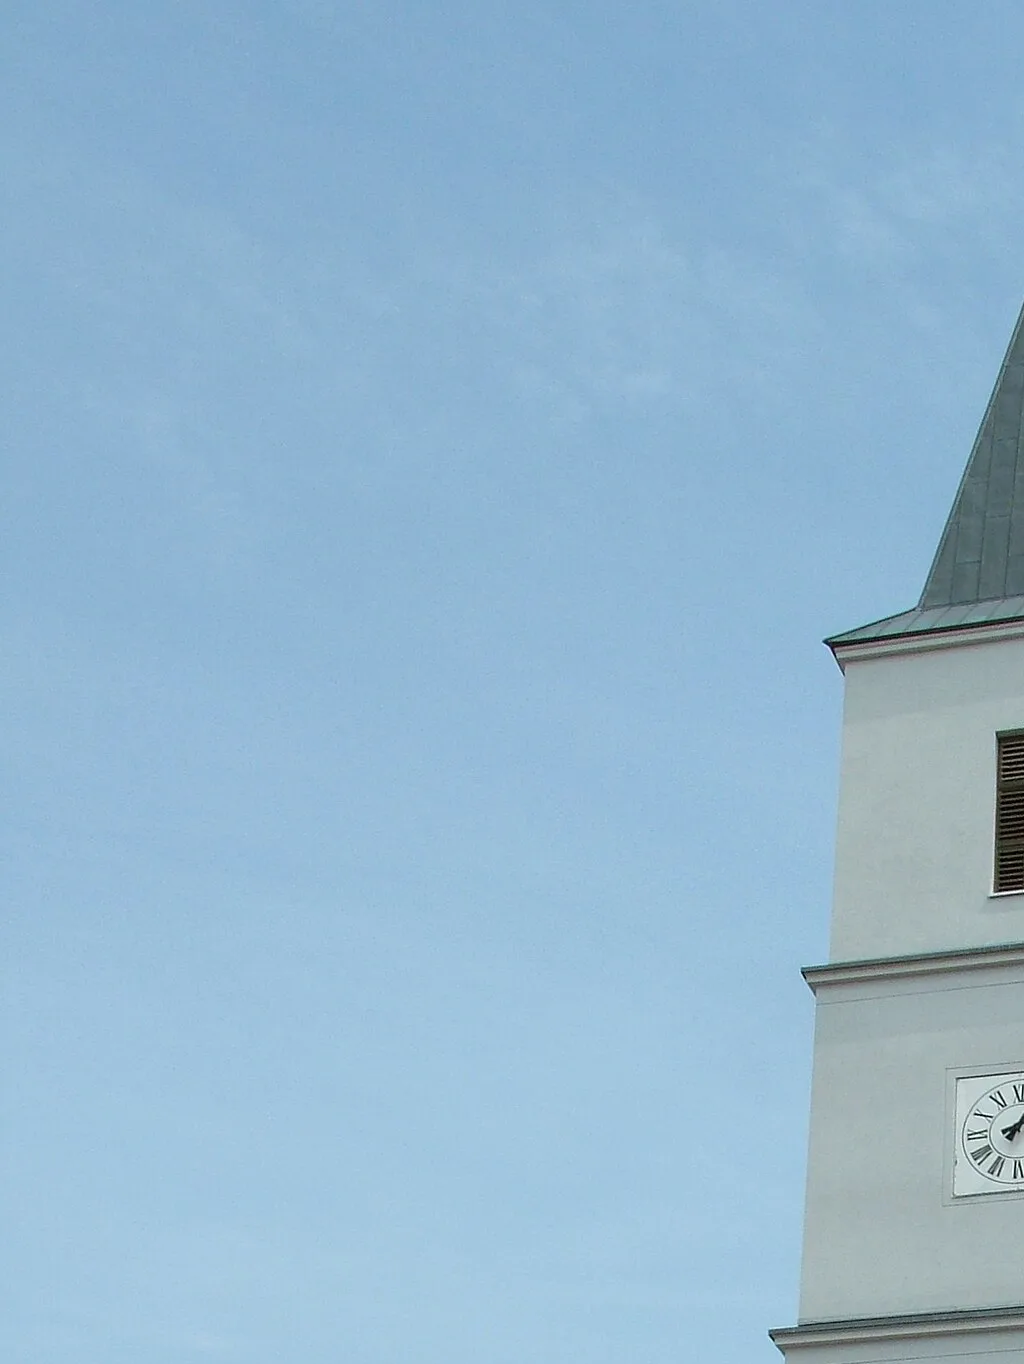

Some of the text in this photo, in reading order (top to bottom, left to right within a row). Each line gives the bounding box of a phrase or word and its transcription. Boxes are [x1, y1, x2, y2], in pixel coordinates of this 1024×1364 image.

[989, 1091, 1007, 1110] XI
[974, 1109, 993, 1123] X
[967, 1129, 988, 1140] IX
[970, 1144, 992, 1165] VIII
[988, 1156, 1005, 1177] VII
[1013, 1160, 1024, 1178] VI
